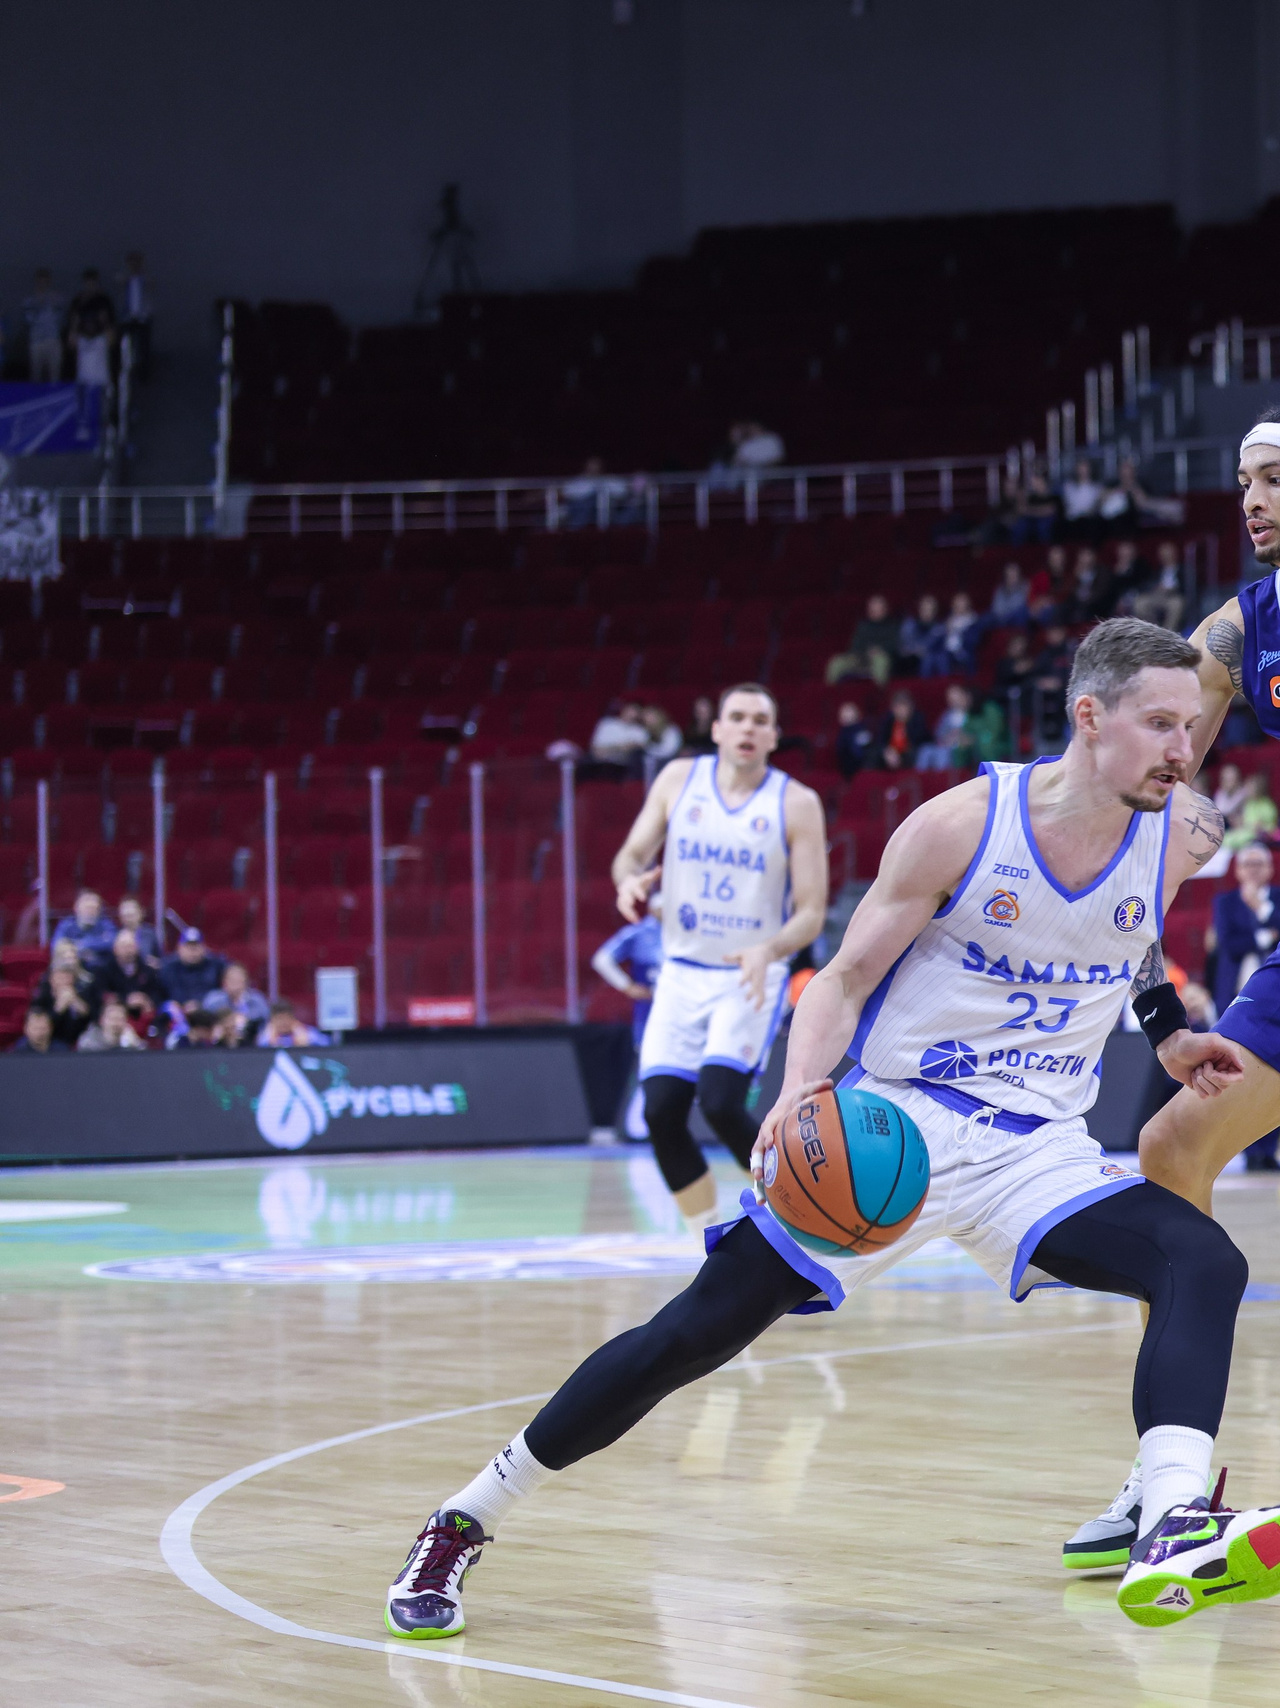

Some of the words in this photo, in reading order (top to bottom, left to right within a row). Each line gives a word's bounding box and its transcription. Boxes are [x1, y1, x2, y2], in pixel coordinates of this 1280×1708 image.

[677, 838, 766, 873] SAMARA
[992, 862, 1030, 880] ZEDO
[700, 871, 735, 902] 16
[996, 991, 1081, 1034] 23
[987, 1048, 1088, 1078] РОССЕТИ
[870, 1105, 891, 1137] FIBA
[797, 1100, 829, 1185] ÖGEL
